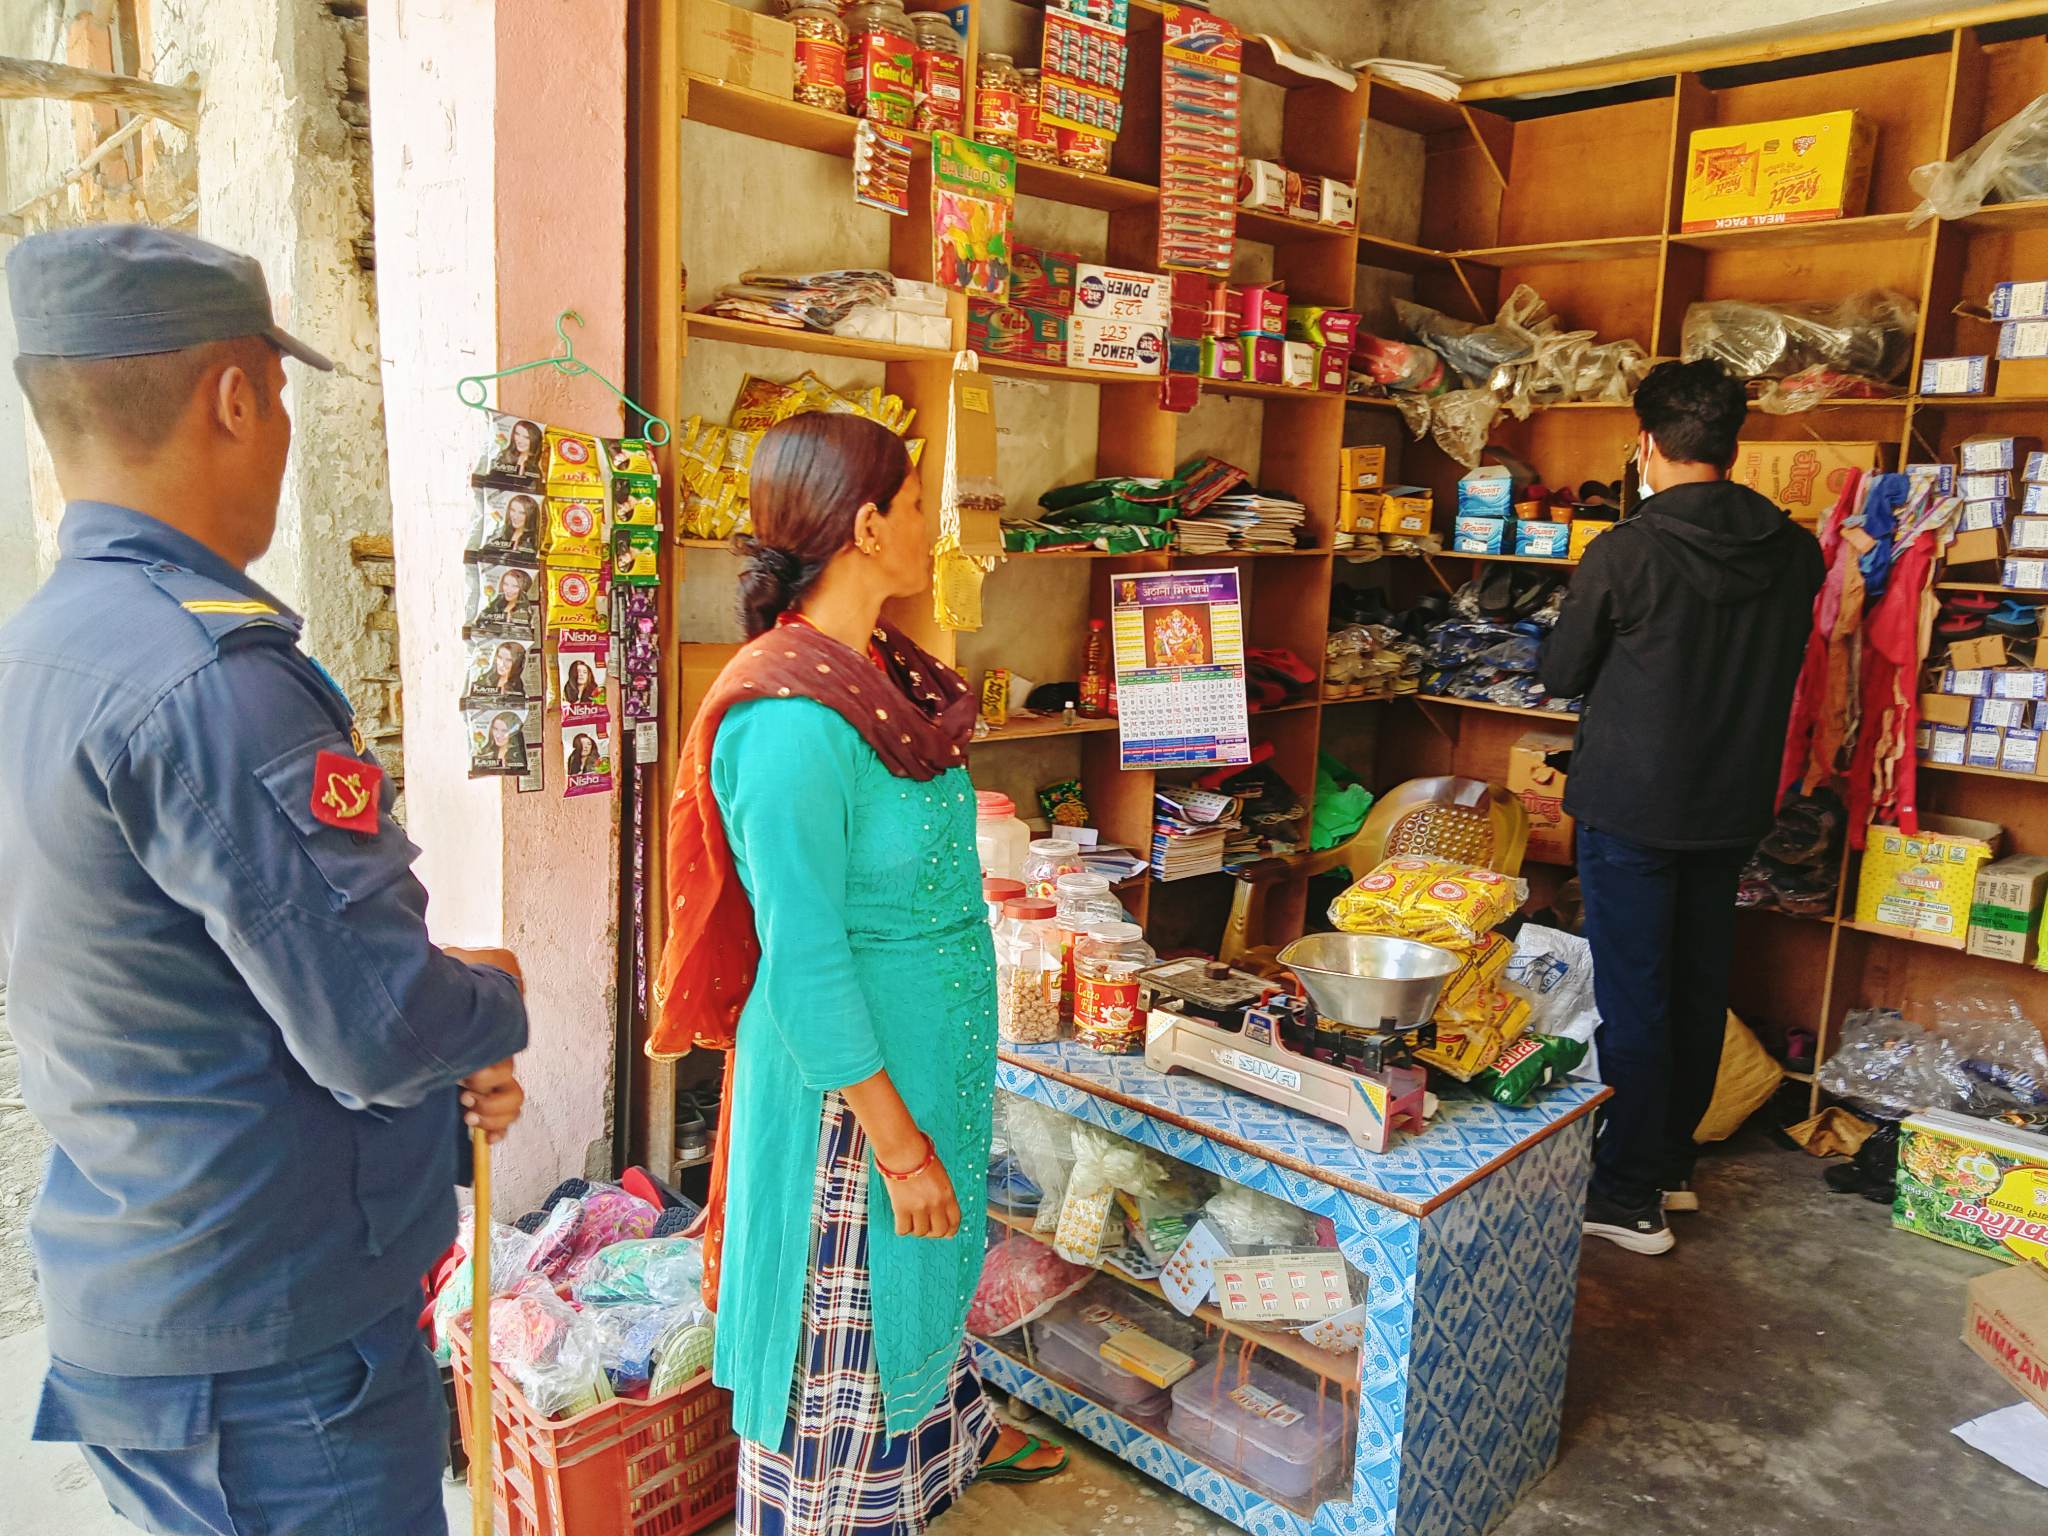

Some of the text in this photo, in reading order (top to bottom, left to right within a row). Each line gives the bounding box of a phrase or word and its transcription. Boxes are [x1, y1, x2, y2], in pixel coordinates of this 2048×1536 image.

[940, 157, 1008, 189] BALLOOS
[1715, 213, 1785, 228] MEAL PACK
[1107, 280, 1150, 298] POWER
[1099, 326, 1128, 340] 123
[1092, 343, 1135, 360] POWER
[564, 631, 597, 642] Nisha
[567, 703, 598, 716] Nisha
[570, 775, 600, 787] Nisha
[1077, 982, 1100, 1001] Lacto
[1238, 1055, 1297, 1088] SIVA
